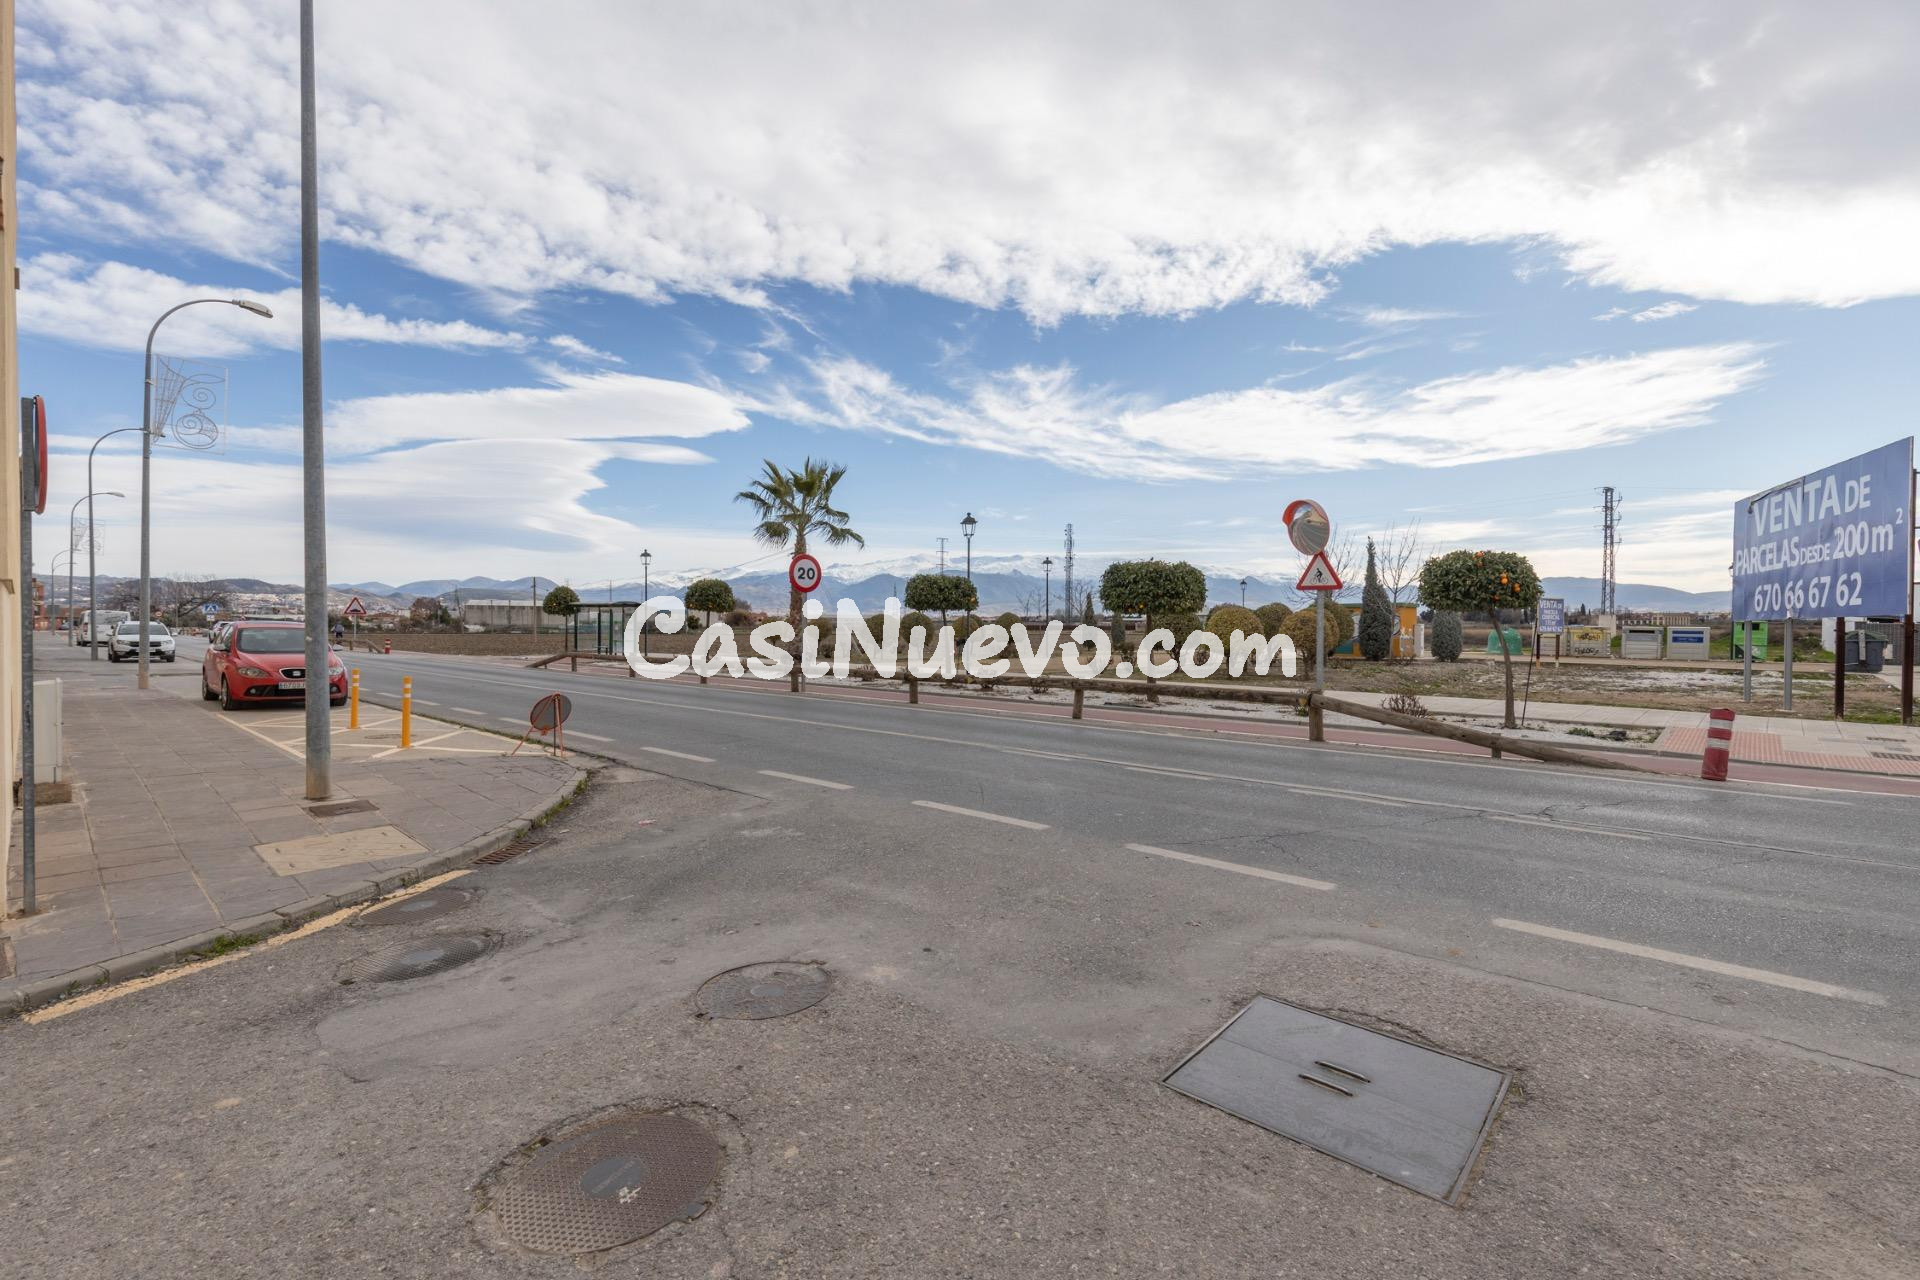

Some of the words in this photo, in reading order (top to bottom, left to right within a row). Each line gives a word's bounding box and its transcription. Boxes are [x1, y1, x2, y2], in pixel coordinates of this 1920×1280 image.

[1753, 475, 1841, 537] VENTA
[1844, 474, 1872, 513] DE
[798, 567, 815, 580] 20
[1735, 536, 1800, 576] PARCELAS
[1801, 542, 1831, 566] DESDE
[1754, 582, 1782, 613] 670
[1784, 578, 1804, 610] 66
[1808, 575, 1831, 609] 67
[1836, 571, 1863, 607] 62
